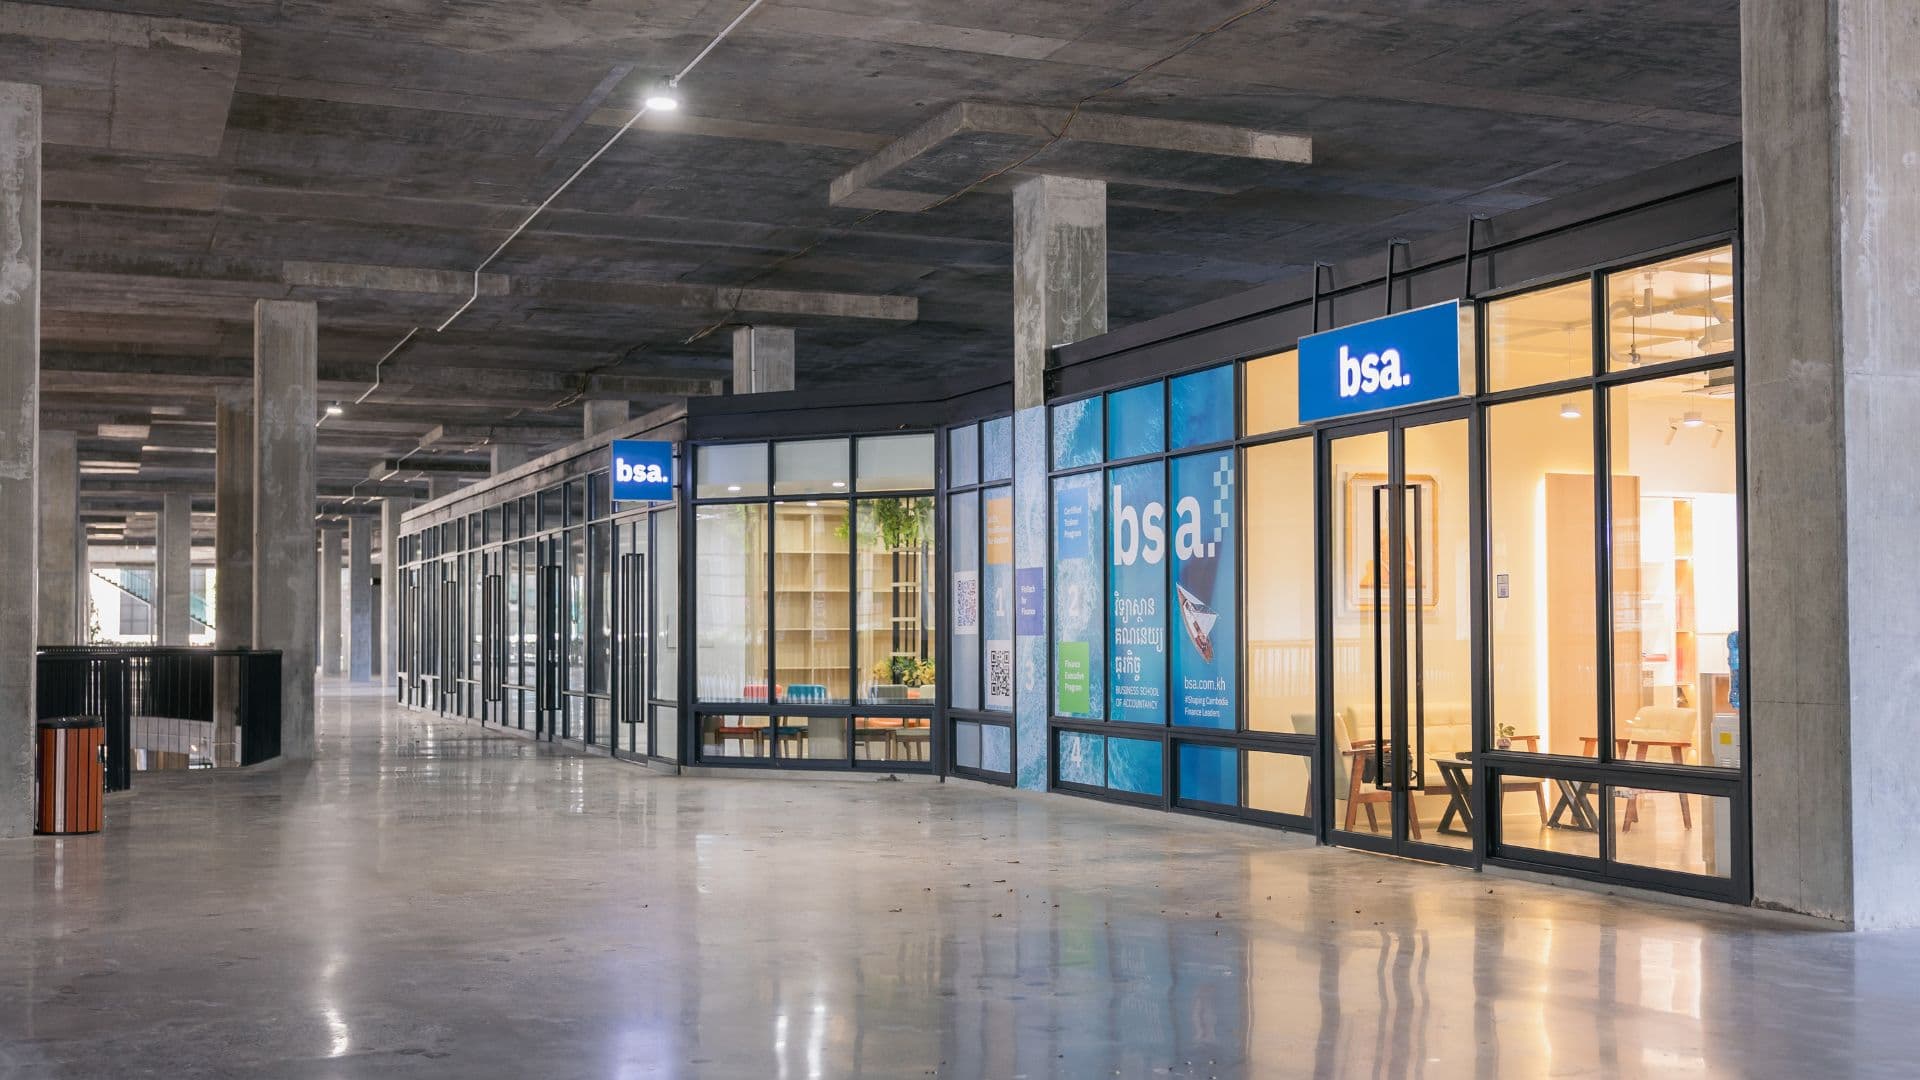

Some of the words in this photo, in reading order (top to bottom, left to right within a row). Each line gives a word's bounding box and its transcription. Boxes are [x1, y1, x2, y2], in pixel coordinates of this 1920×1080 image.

[1339, 345, 1410, 397] bsa.
[616, 457, 668, 483] bsa.
[995, 586, 1005, 617] 1
[1068, 583, 1080, 617] 2
[1115, 685, 1139, 695] BUSINESS
[1140, 687, 1160, 697] SCHOOL
[1184, 677, 1226, 691] bsa.com.kh
[1115, 698, 1123, 707] OF
[1123, 699, 1158, 710] ACCOUNTANCY
[1184, 695, 1206, 706] #Shaping
[1206, 697, 1229, 706] Cambodia
[1184, 706, 1202, 716] Finance
[1202, 708, 1220, 718] Leaders
